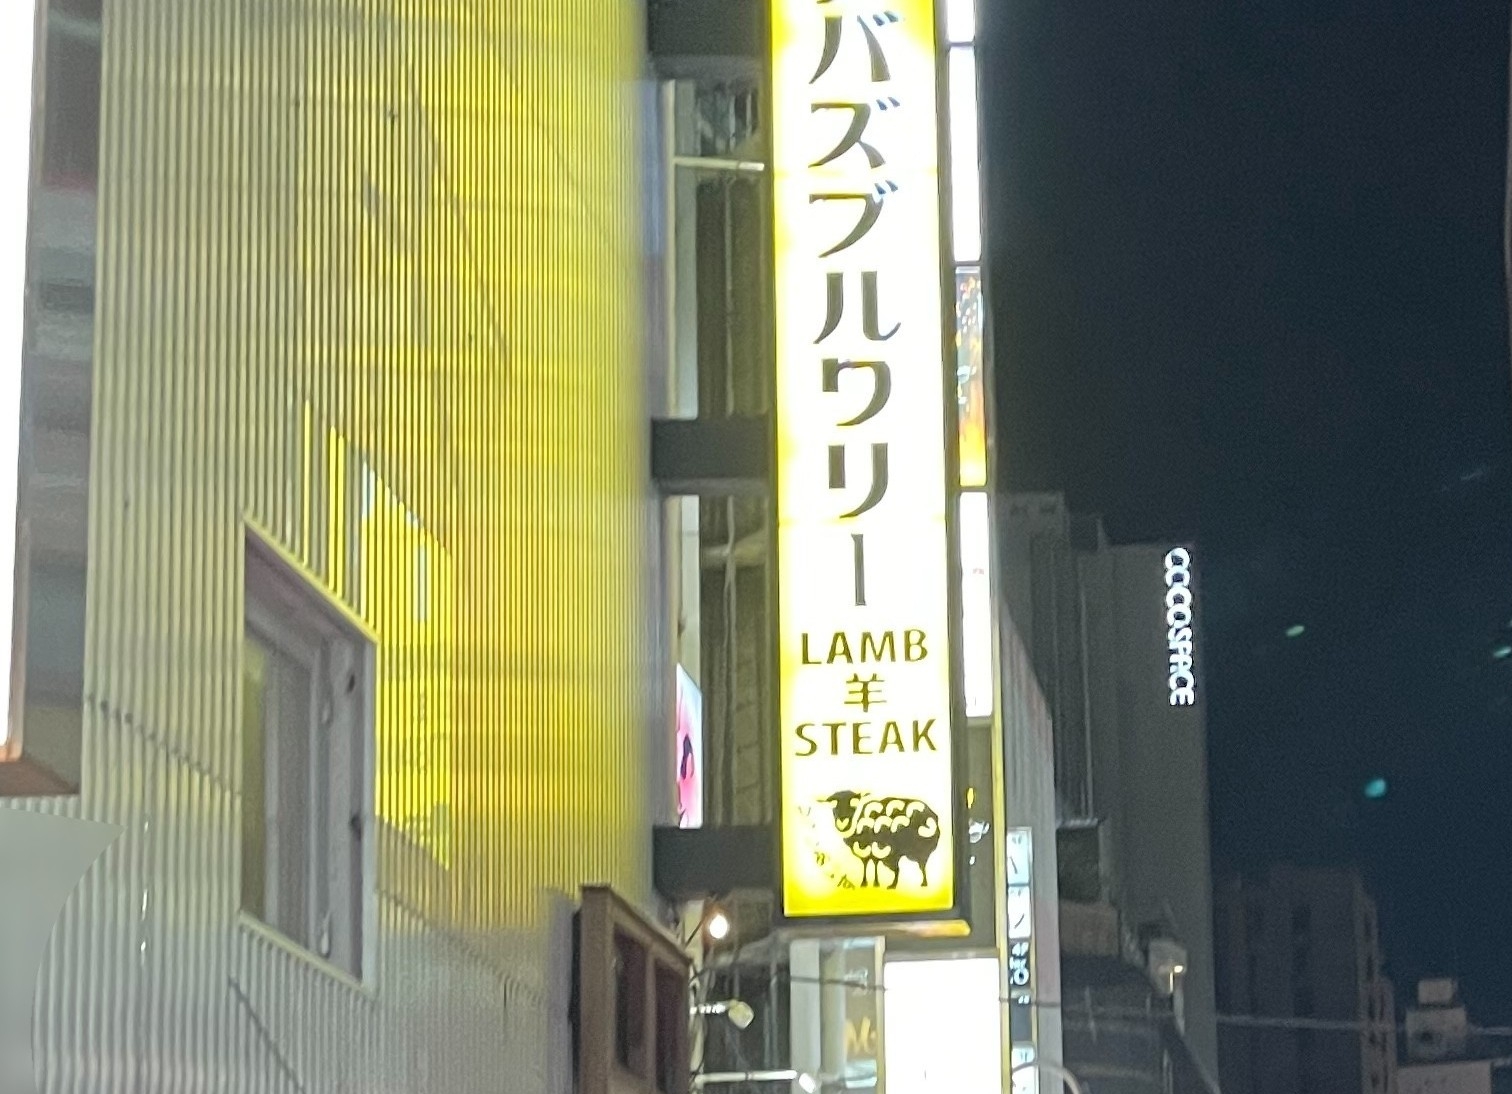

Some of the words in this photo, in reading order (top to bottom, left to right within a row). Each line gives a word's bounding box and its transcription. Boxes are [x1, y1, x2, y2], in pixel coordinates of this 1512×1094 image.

[808, 0, 901, 607] バズブルワリー
[801, 628, 929, 666] LAMB
[844, 672, 887, 713] 羊
[795, 718, 938, 757] STEAK
